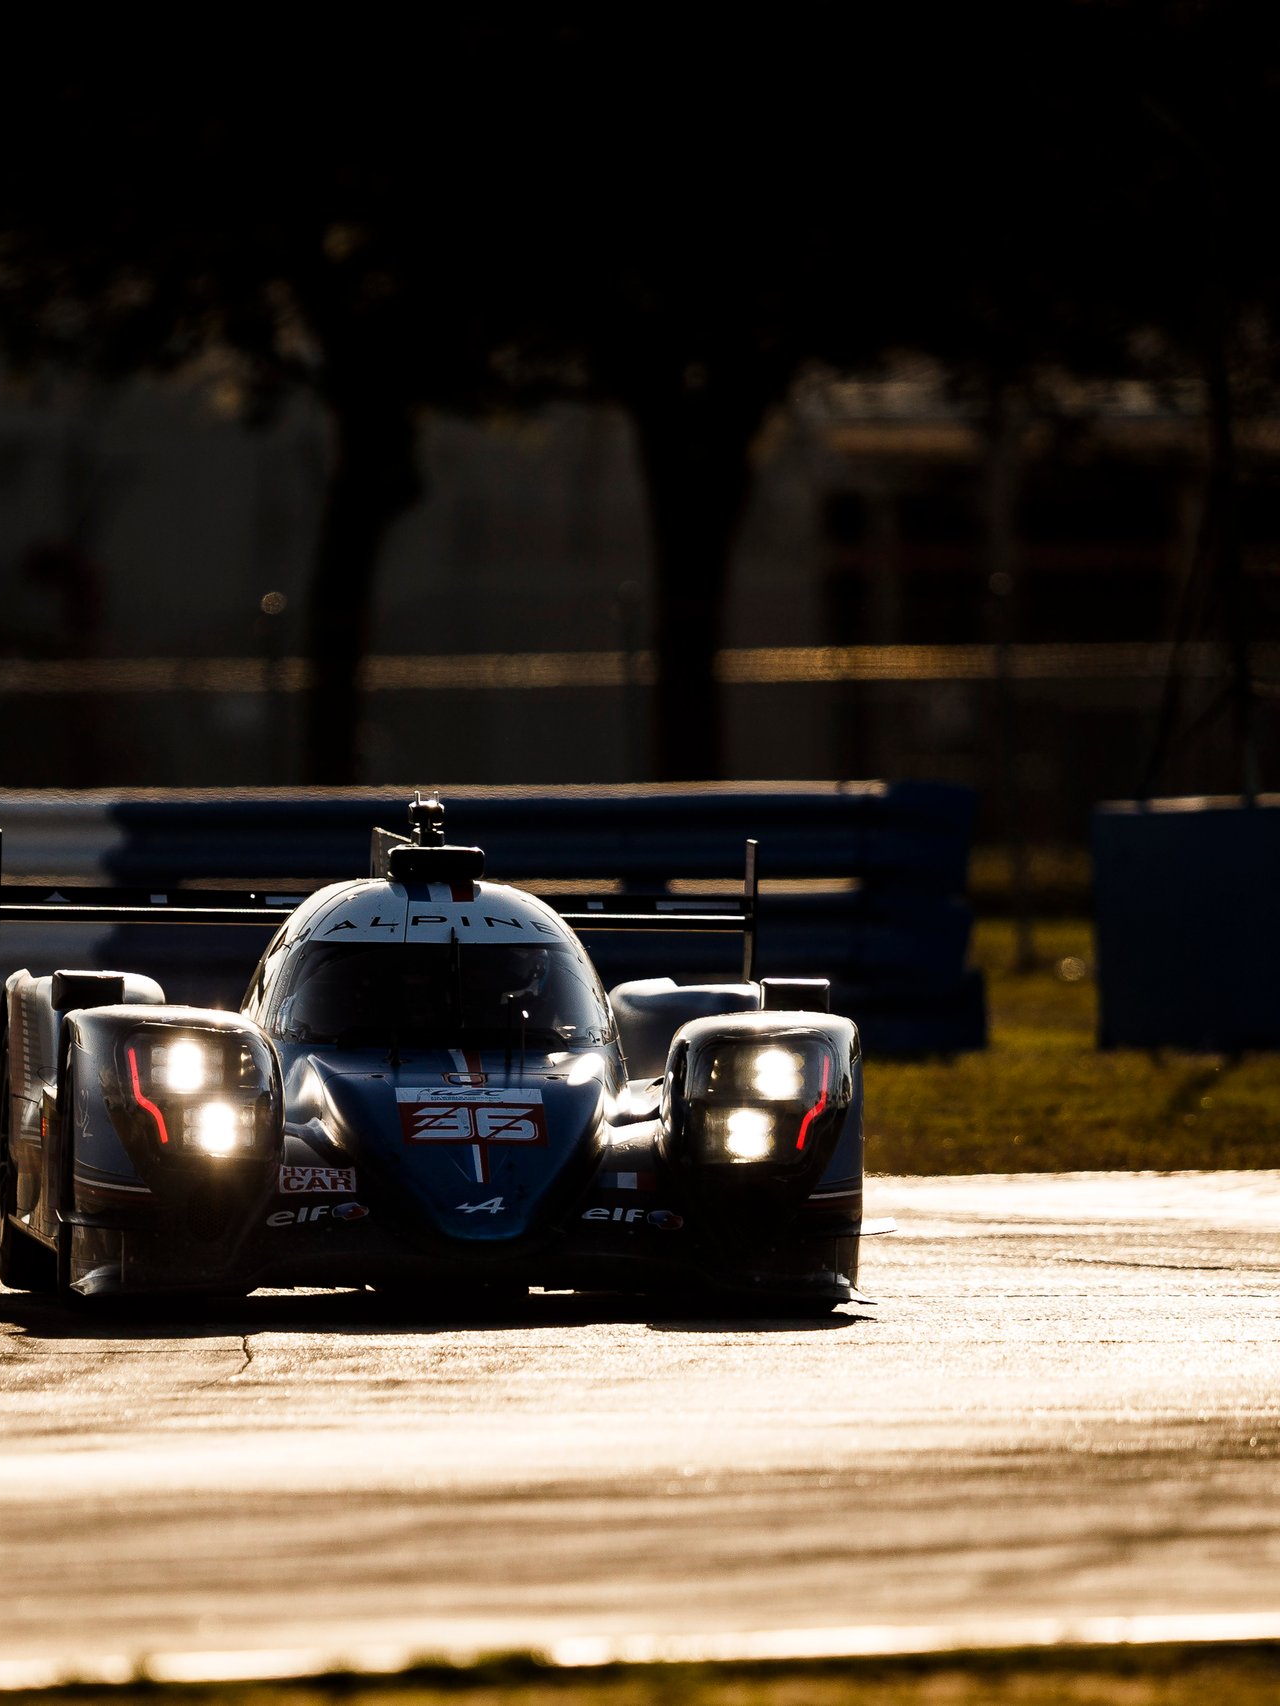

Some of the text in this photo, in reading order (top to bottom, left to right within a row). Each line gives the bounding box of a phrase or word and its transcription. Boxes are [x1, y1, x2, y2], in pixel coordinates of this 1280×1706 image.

[323, 915, 559, 938] ALPINE
[410, 1106, 539, 1141] 36
[282, 1166, 352, 1179] HYPER
[282, 1176, 352, 1191] CAR
[266, 1205, 330, 1228] elf
[580, 1206, 645, 1225] elf
